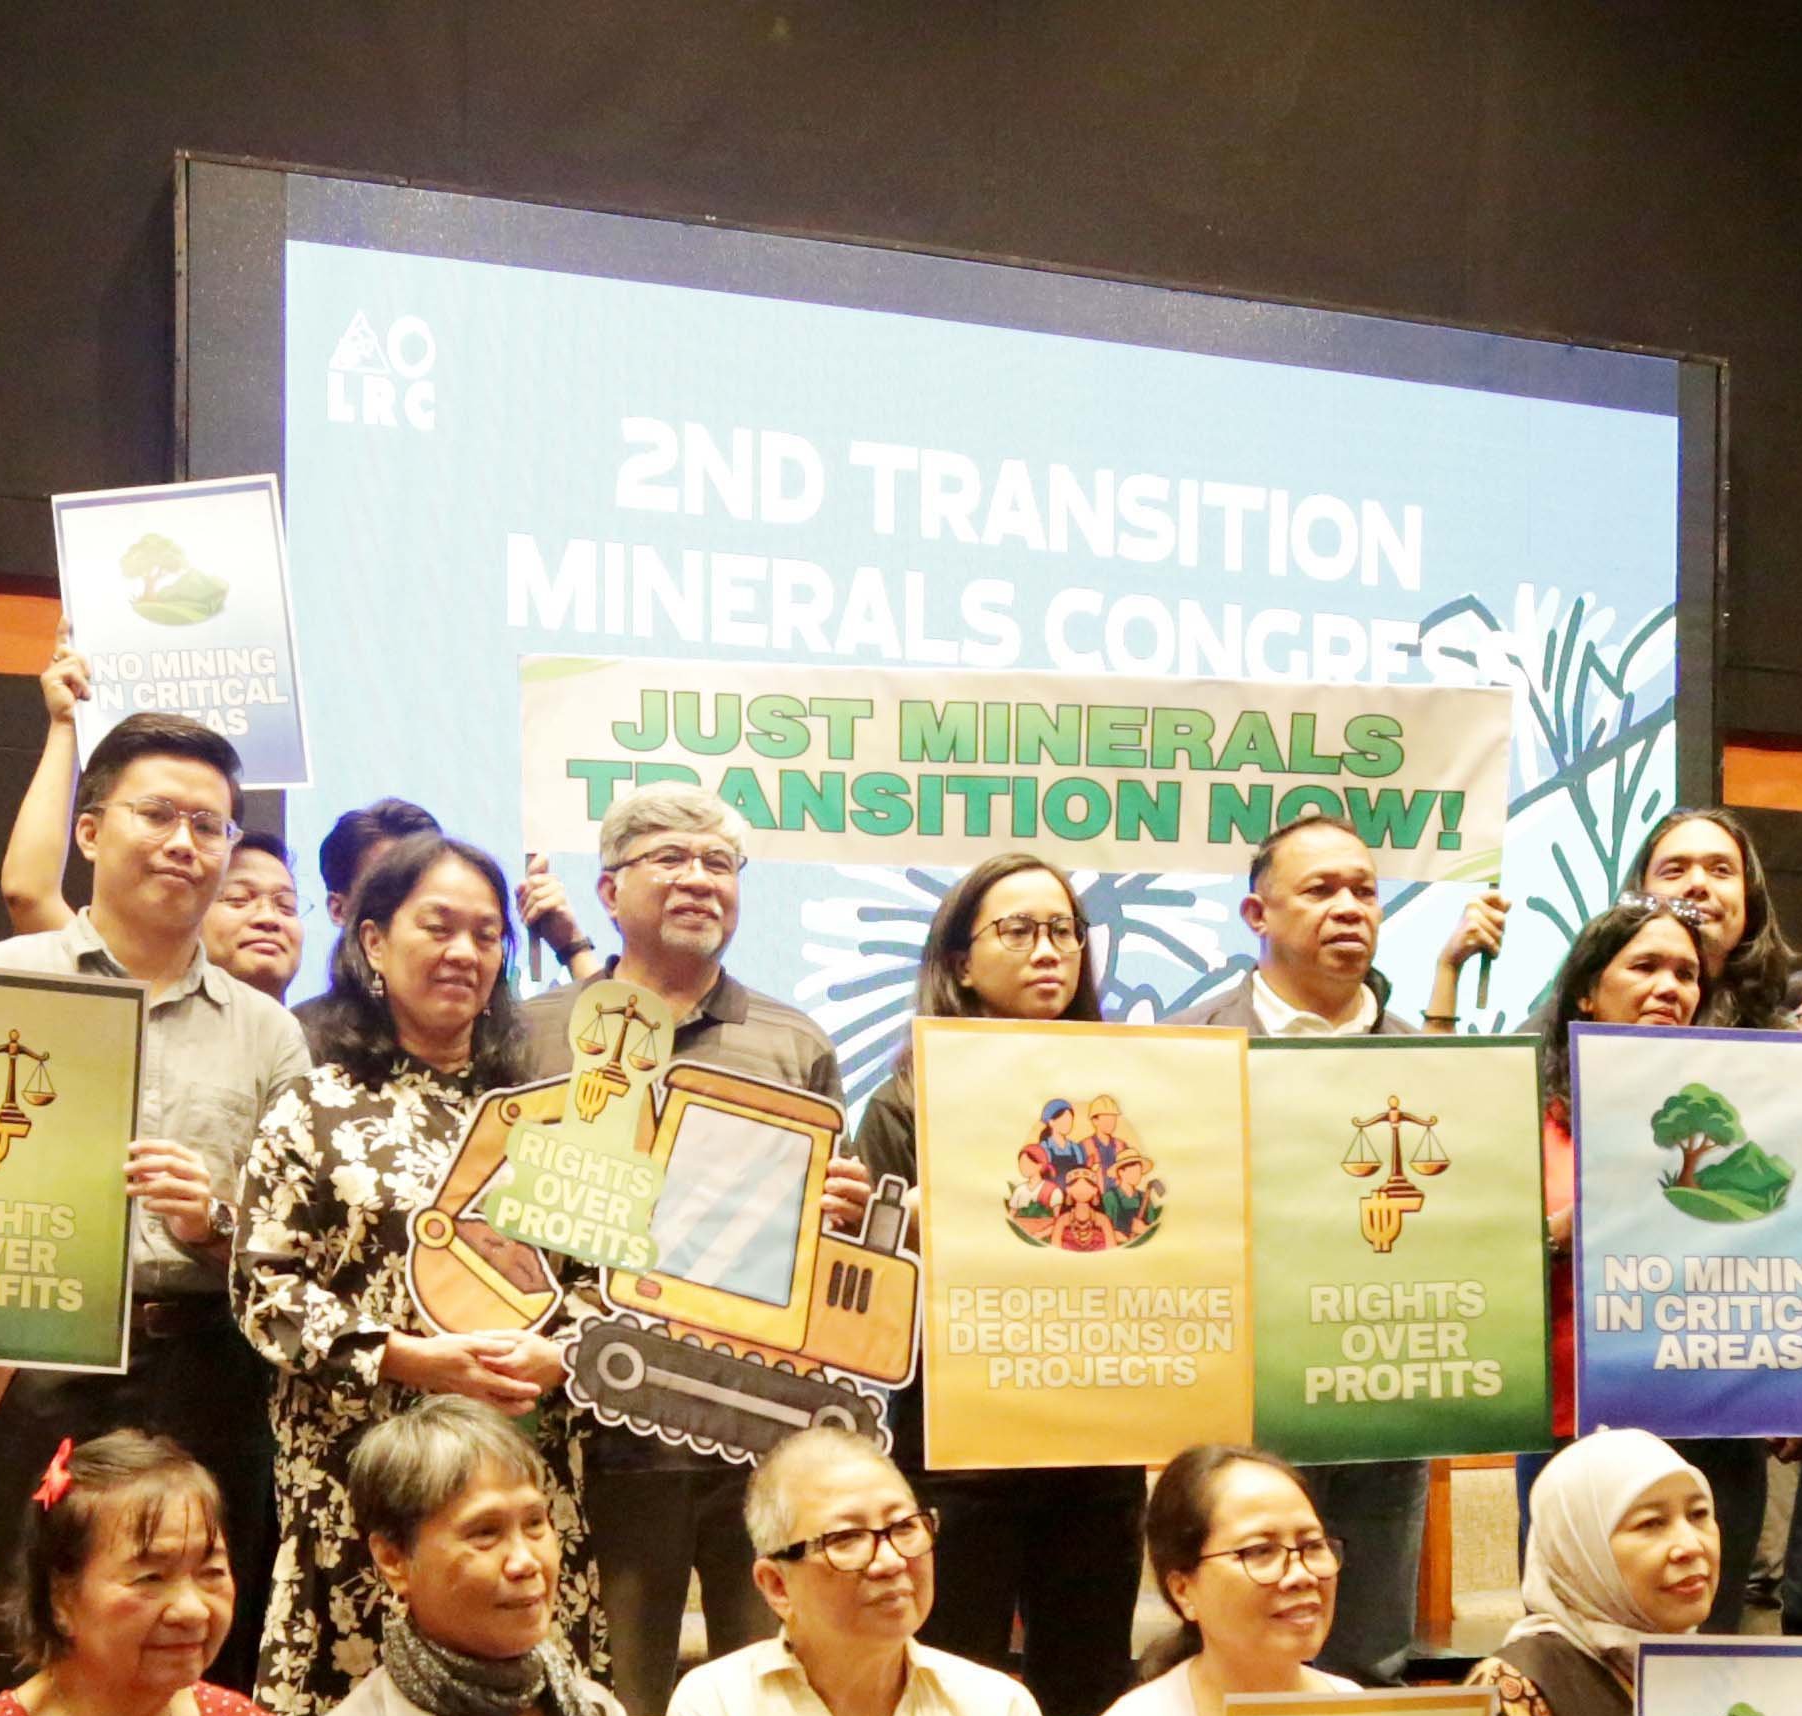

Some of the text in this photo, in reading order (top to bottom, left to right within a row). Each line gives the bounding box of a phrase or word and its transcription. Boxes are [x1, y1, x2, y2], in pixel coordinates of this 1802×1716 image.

[327, 372, 436, 431] LRC
[615, 416, 1423, 592] 2ND TRANSITION
[506, 532, 1023, 670] MINERALS
[93, 647, 277, 682] NO MINING
[132, 678, 289, 709] CRITICAL
[611, 688, 1404, 778] JUST MINERALS
[1208, 783, 1465, 850] NOW!
[517, 1131, 654, 1198] RIGHTS
[533, 1173, 631, 1228] OVER
[495, 1197, 652, 1268] PROFITS
[1603, 1254, 1673, 1292] NO
[948, 1287, 1233, 1320] PEOPLE MAKE
[1310, 1280, 1486, 1323] RIGHTS
[1596, 1295, 1646, 1333] IN
[948, 1321, 1233, 1354] DECISIONS ON
[1341, 1321, 1468, 1361] OVER
[988, 1355, 1197, 1389] PROJECTS
[1305, 1360, 1504, 1405] PROFITS
